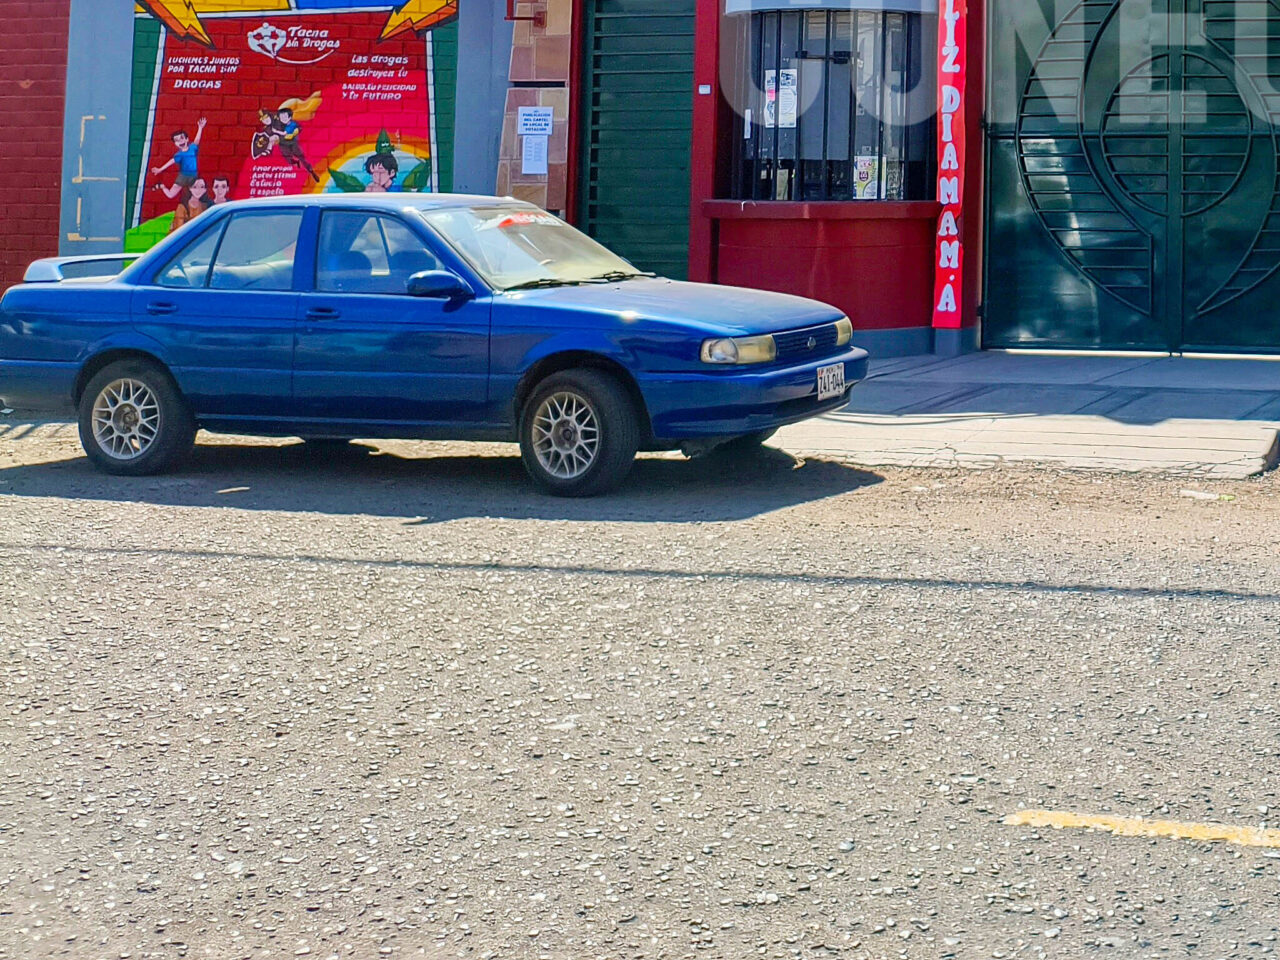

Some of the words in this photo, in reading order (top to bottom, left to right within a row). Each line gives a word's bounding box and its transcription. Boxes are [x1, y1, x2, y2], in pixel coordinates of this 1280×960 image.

[288, 25, 329, 37] Tacna
[303, 38, 340, 51] Drogas
[371, 54, 409, 66] drogas
[167, 65, 184, 73] POR
[188, 65, 216, 73] TACNA
[174, 79, 222, 89] DROGAS
[941, 85, 960, 170] DIA
